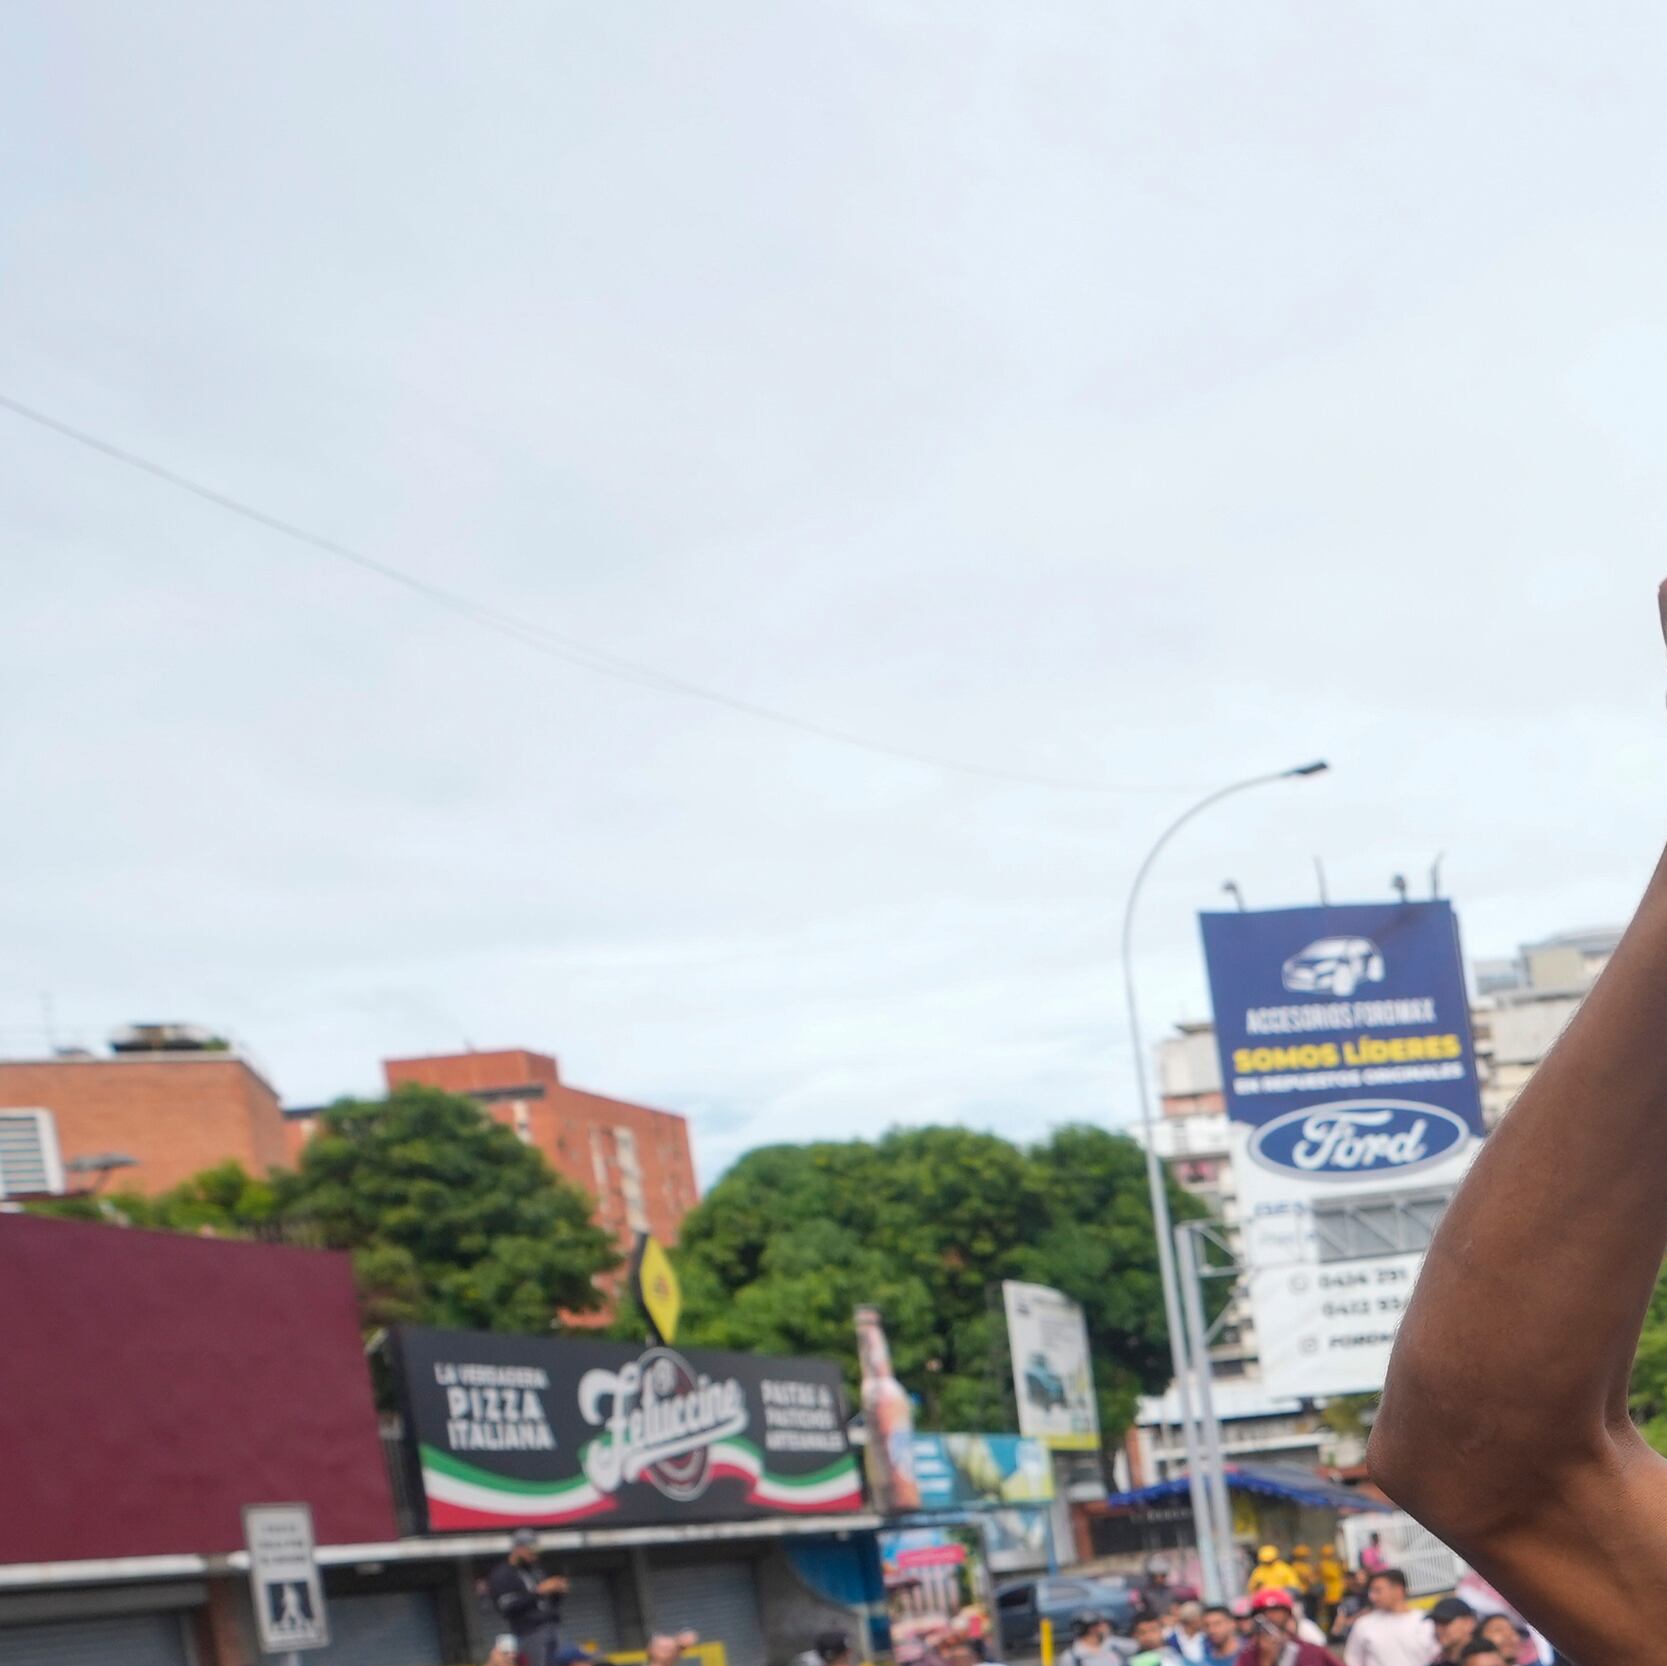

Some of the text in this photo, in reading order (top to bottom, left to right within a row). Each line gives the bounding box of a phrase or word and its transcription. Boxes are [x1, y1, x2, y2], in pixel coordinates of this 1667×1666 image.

[1246, 1001, 1354, 1034] ACCESORIOS
[1233, 1034, 1462, 1073] SOMOS LÍDERES
[1260, 1069, 1363, 1092] REPUESTOS
[1362, 1061, 1465, 1086] ORIGINALES
[1292, 1109, 1428, 1170] Ford
[447, 1386, 545, 1421] PIZZA
[447, 1420, 557, 1450] ITALIANA
